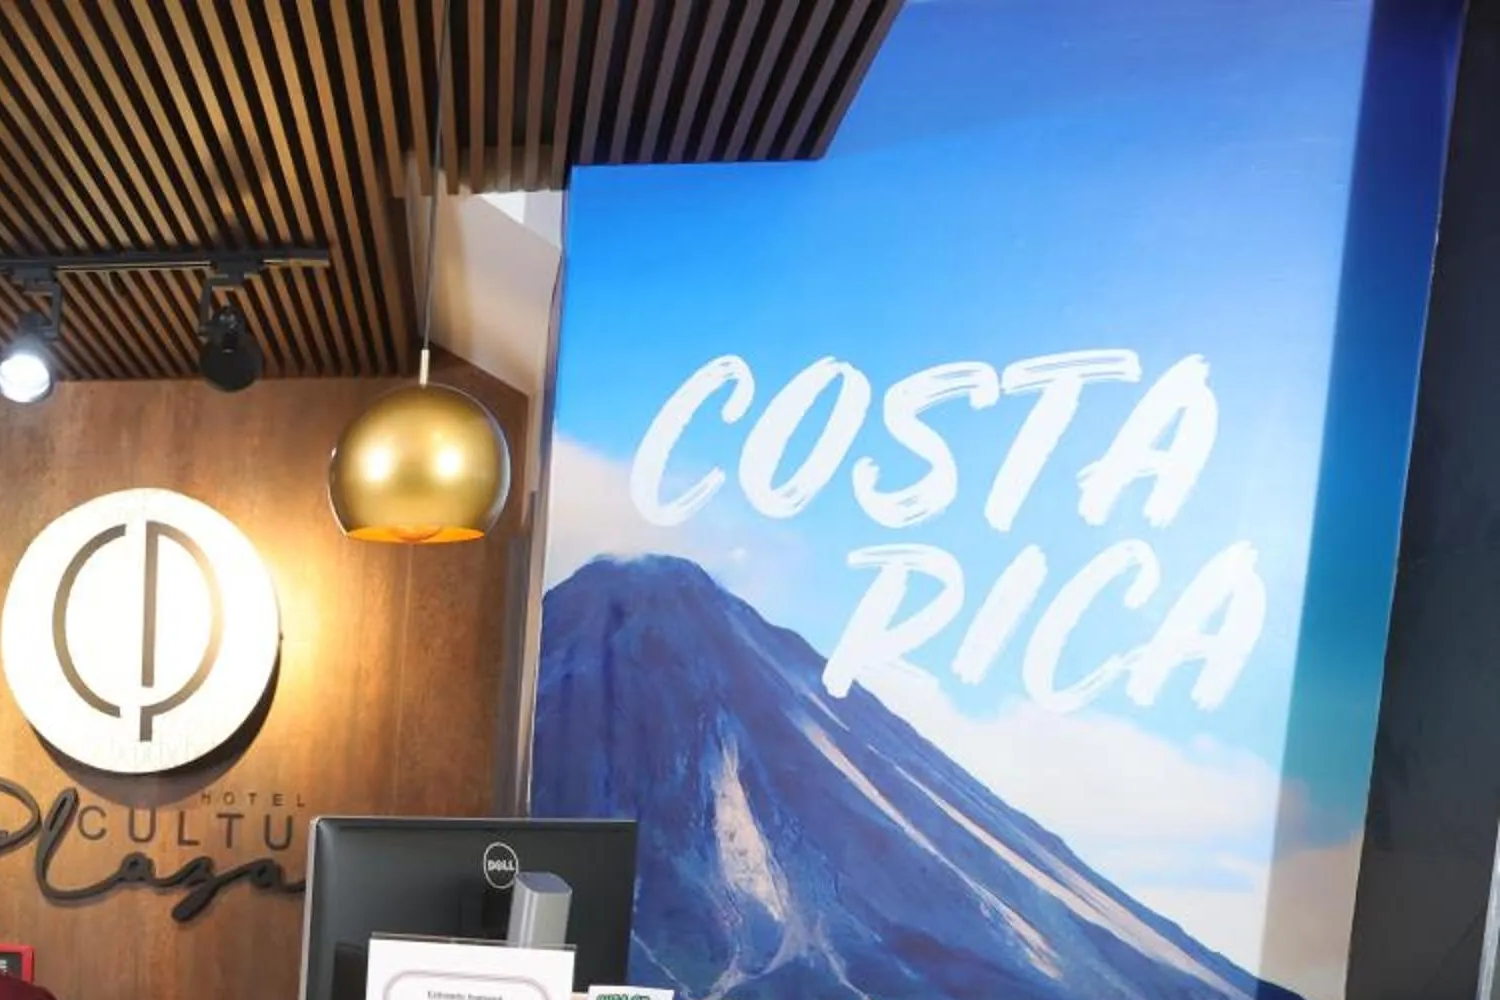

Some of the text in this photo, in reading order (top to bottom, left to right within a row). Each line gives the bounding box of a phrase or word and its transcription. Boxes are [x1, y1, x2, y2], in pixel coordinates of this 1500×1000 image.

[630, 348, 1219, 532] COSTA
[821, 537, 1267, 713] RICA
[201, 791, 306, 808] HOTEL
[77, 805, 294, 852] CULTU
[487, 859, 515, 872] DELL
